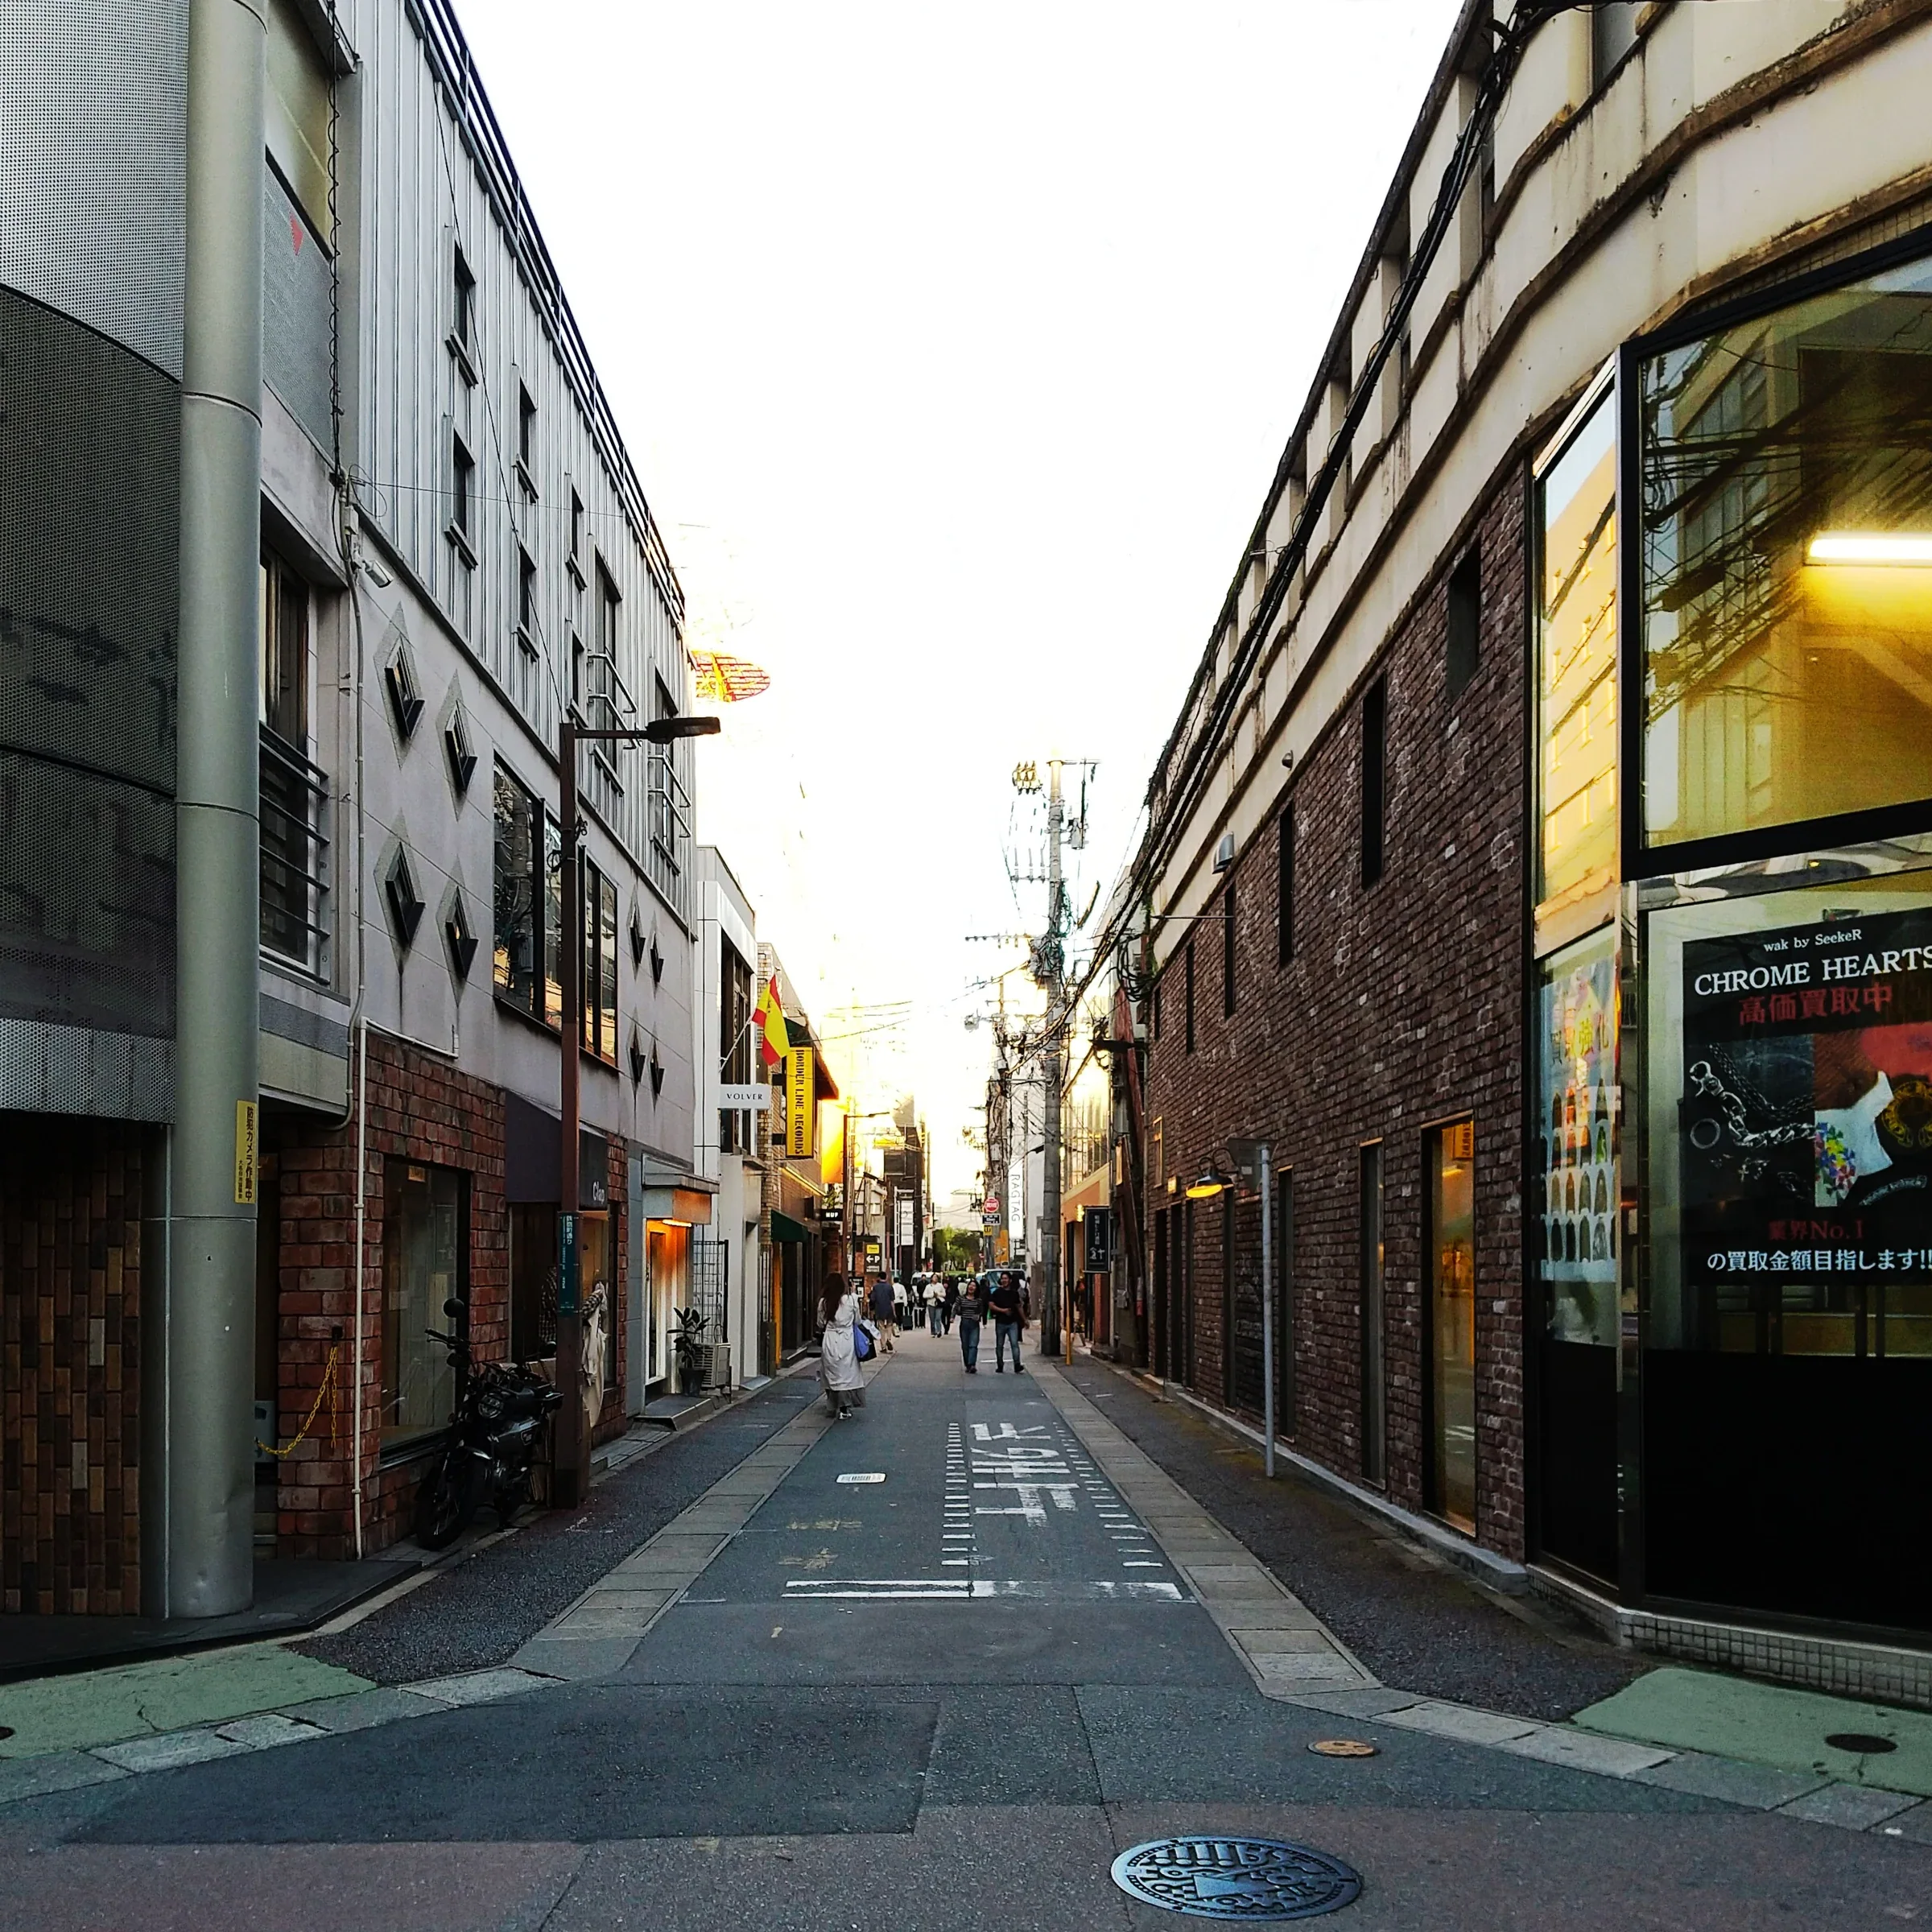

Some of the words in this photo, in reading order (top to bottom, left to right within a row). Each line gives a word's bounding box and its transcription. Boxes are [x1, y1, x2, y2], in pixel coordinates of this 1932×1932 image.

[1764, 939, 1789, 952] wak
[1794, 936, 1810, 948] by
[1815, 928, 1863, 946] SeekeR
[1695, 962, 1810, 996] CHROME
[1823, 945, 1932, 981] HEARTS
[1739, 982, 1893, 1026] 高価買取中
[795, 1049, 804, 1085] BORDER
[727, 1092, 762, 1100] VOLVER
[795, 1088, 804, 1110] LINE
[795, 1114, 804, 1155] RECORDS
[1011, 1174, 1021, 1222] RAGTAG
[1768, 1219, 1864, 1241] 業界No.1
[874, 1255, 880, 1263] P
[970, 1422, 1080, 1529] 止まれ
